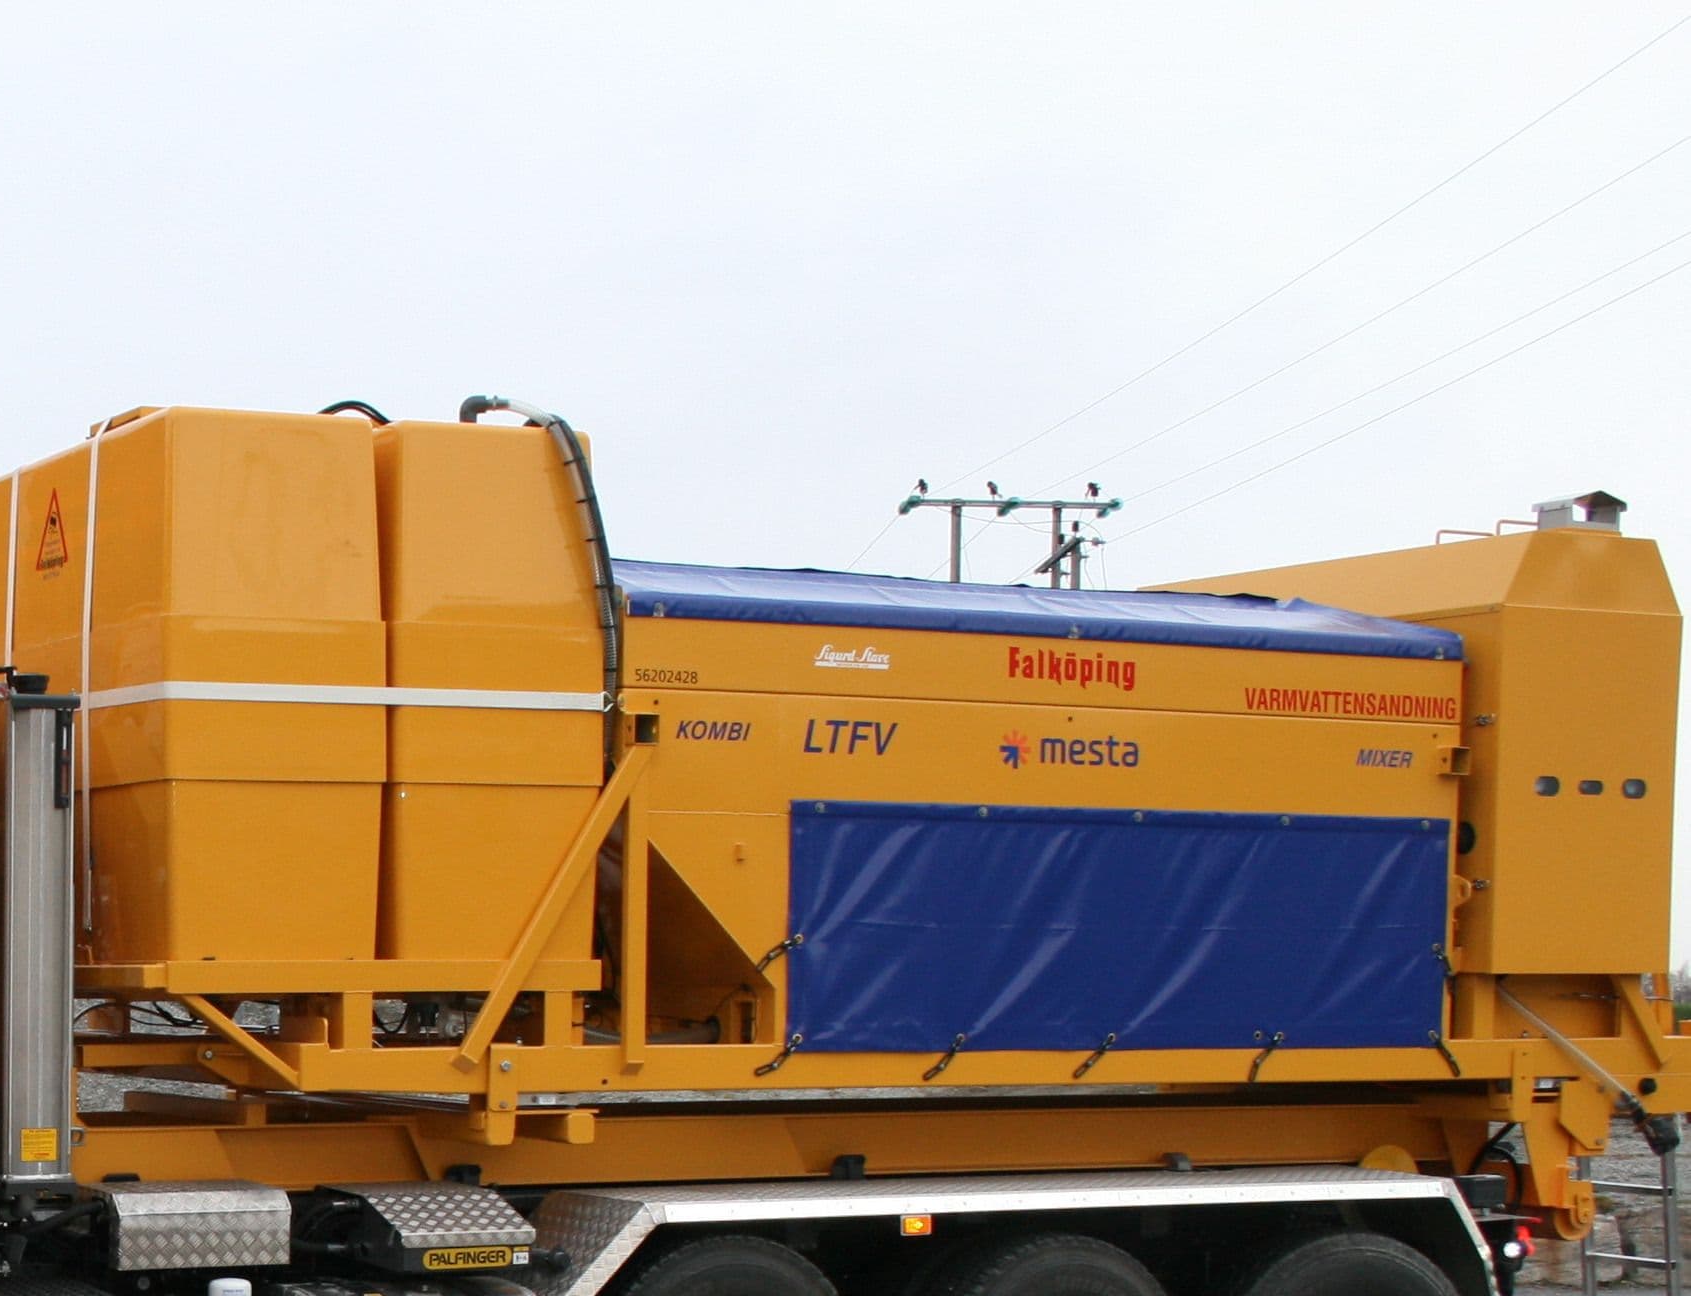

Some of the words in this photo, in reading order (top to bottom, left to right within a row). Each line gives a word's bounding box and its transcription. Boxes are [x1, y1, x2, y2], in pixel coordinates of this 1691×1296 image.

[635, 668, 699, 684] 56202428
[1009, 646, 1136, 692] Falköping
[1245, 687, 1457, 720] VARMVATTENSANDNING
[676, 720, 751, 741] KOMBI
[803, 718, 898, 755] LTFV
[1039, 735, 1139, 768] mesta
[1356, 749, 1413, 768] MIXER
[428, 1250, 506, 1267] PALFINGER
